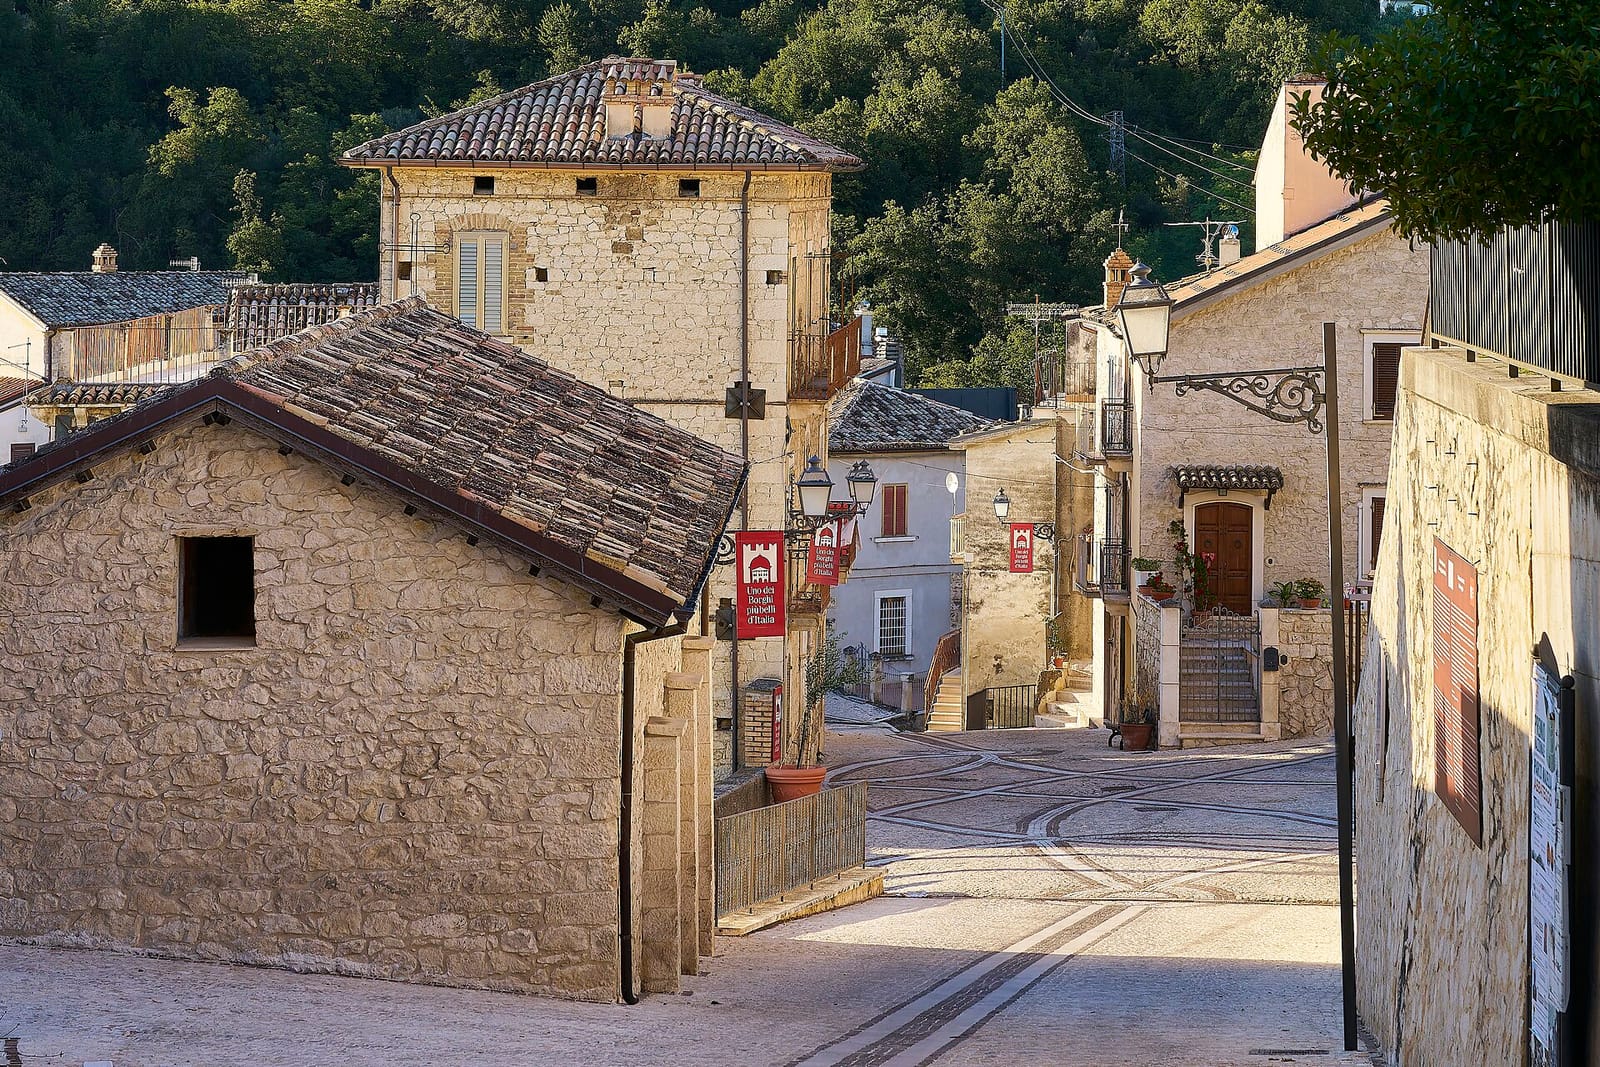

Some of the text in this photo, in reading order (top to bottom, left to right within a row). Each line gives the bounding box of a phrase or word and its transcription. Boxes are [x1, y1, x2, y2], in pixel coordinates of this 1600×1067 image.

[747, 586, 775, 595] Uno dei
[748, 595, 774, 605] Borghi
[747, 615, 775, 624] d'Italia
